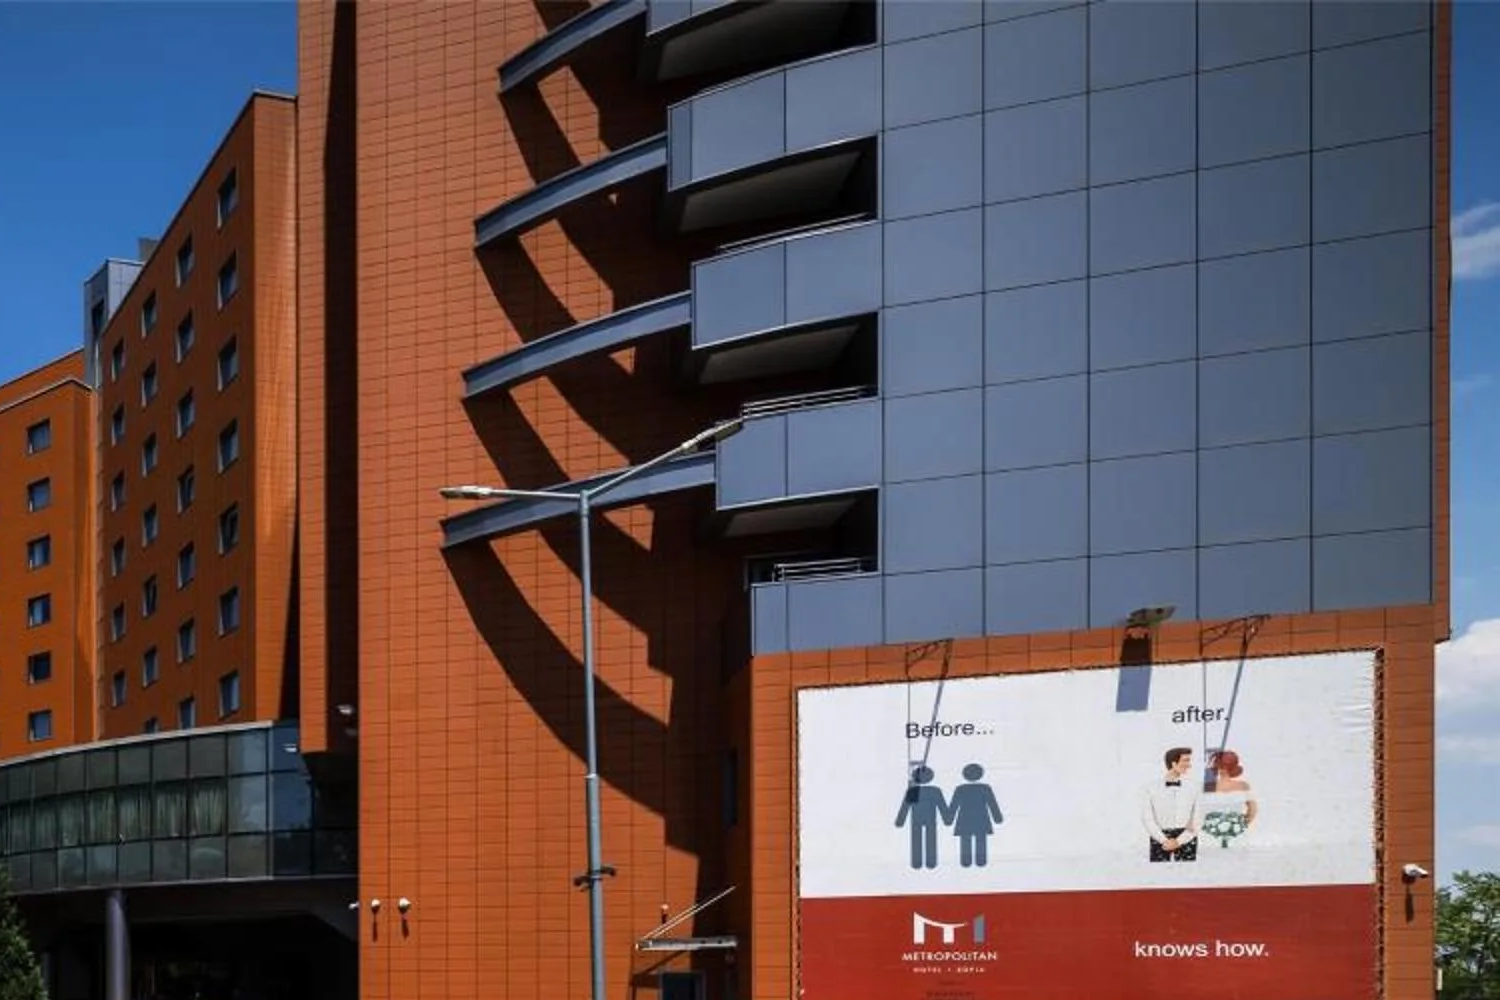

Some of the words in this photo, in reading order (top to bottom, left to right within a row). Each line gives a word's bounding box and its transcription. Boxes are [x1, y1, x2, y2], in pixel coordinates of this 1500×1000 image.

[1171, 705, 1228, 723] after.
[901, 951, 998, 961] METROPOLITAN
[1135, 940, 1208, 957] knows
[1215, 940, 1269, 957] how.
